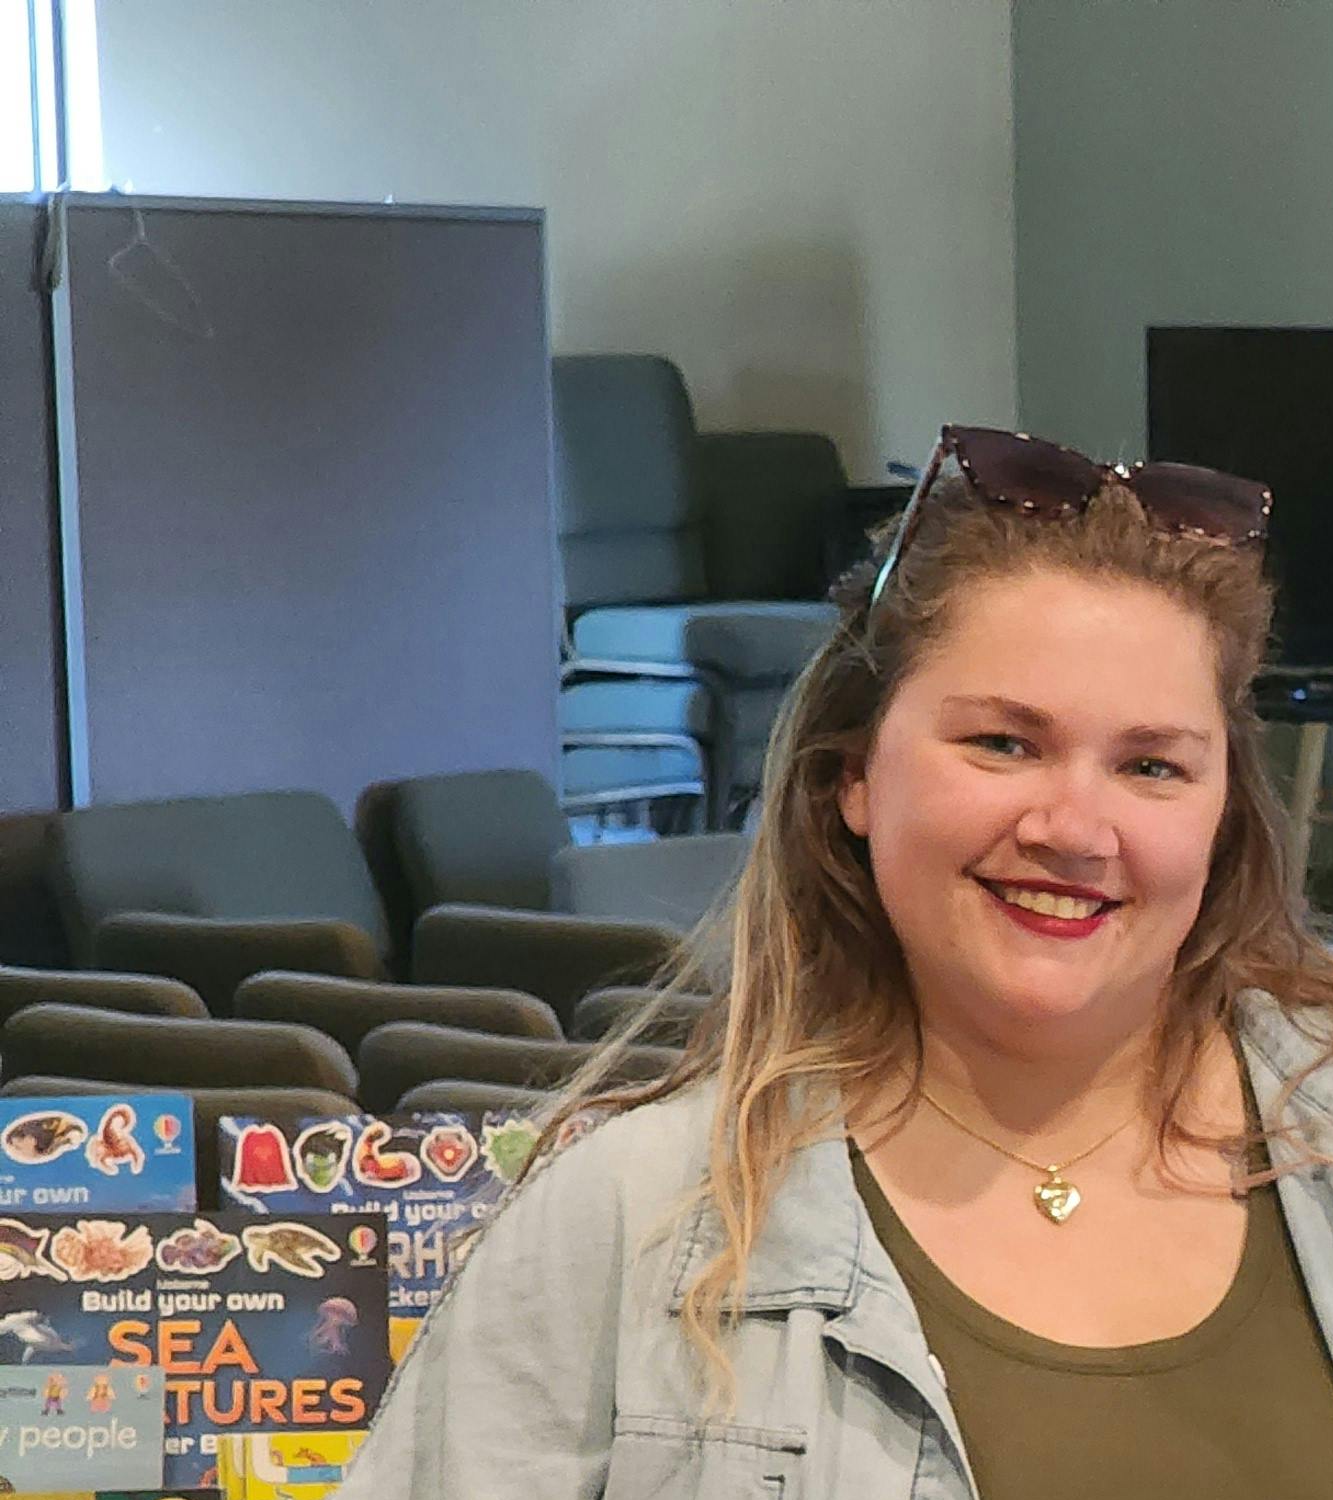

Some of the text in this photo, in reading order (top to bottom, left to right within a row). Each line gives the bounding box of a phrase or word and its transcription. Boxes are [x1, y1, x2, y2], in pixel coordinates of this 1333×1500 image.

[32, 1186, 90, 1205] own
[404, 1203, 464, 1226] your
[82, 1291, 285, 1316] Build your own
[108, 1318, 260, 1375] SEA
[164, 1378, 366, 1425] TURES
[19, 1418, 137, 1460] people
